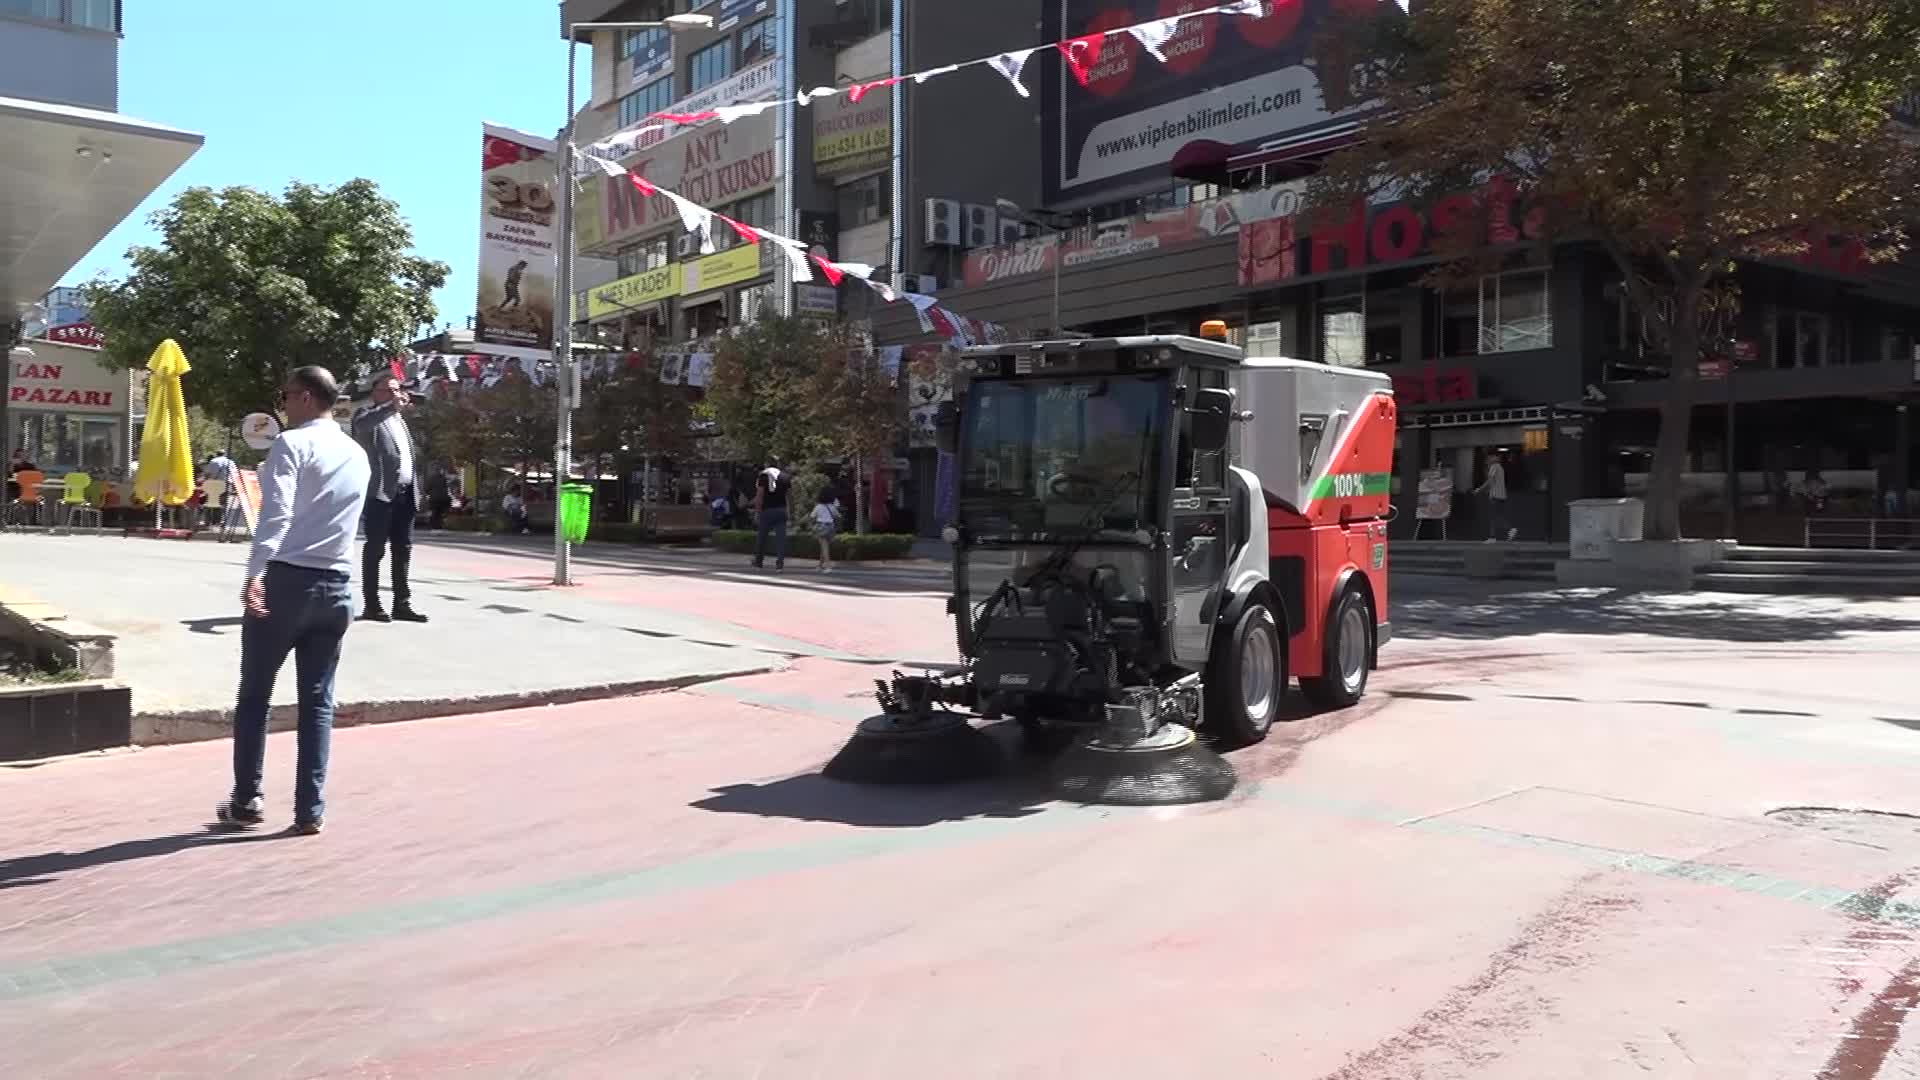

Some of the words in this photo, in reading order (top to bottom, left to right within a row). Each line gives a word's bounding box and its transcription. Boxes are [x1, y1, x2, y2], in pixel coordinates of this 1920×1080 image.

[1096, 87, 1301, 158] www.vipfenbilimleri.com
[718, 150, 776, 198] KURSU
[11, 386, 112, 406] PAZARI
